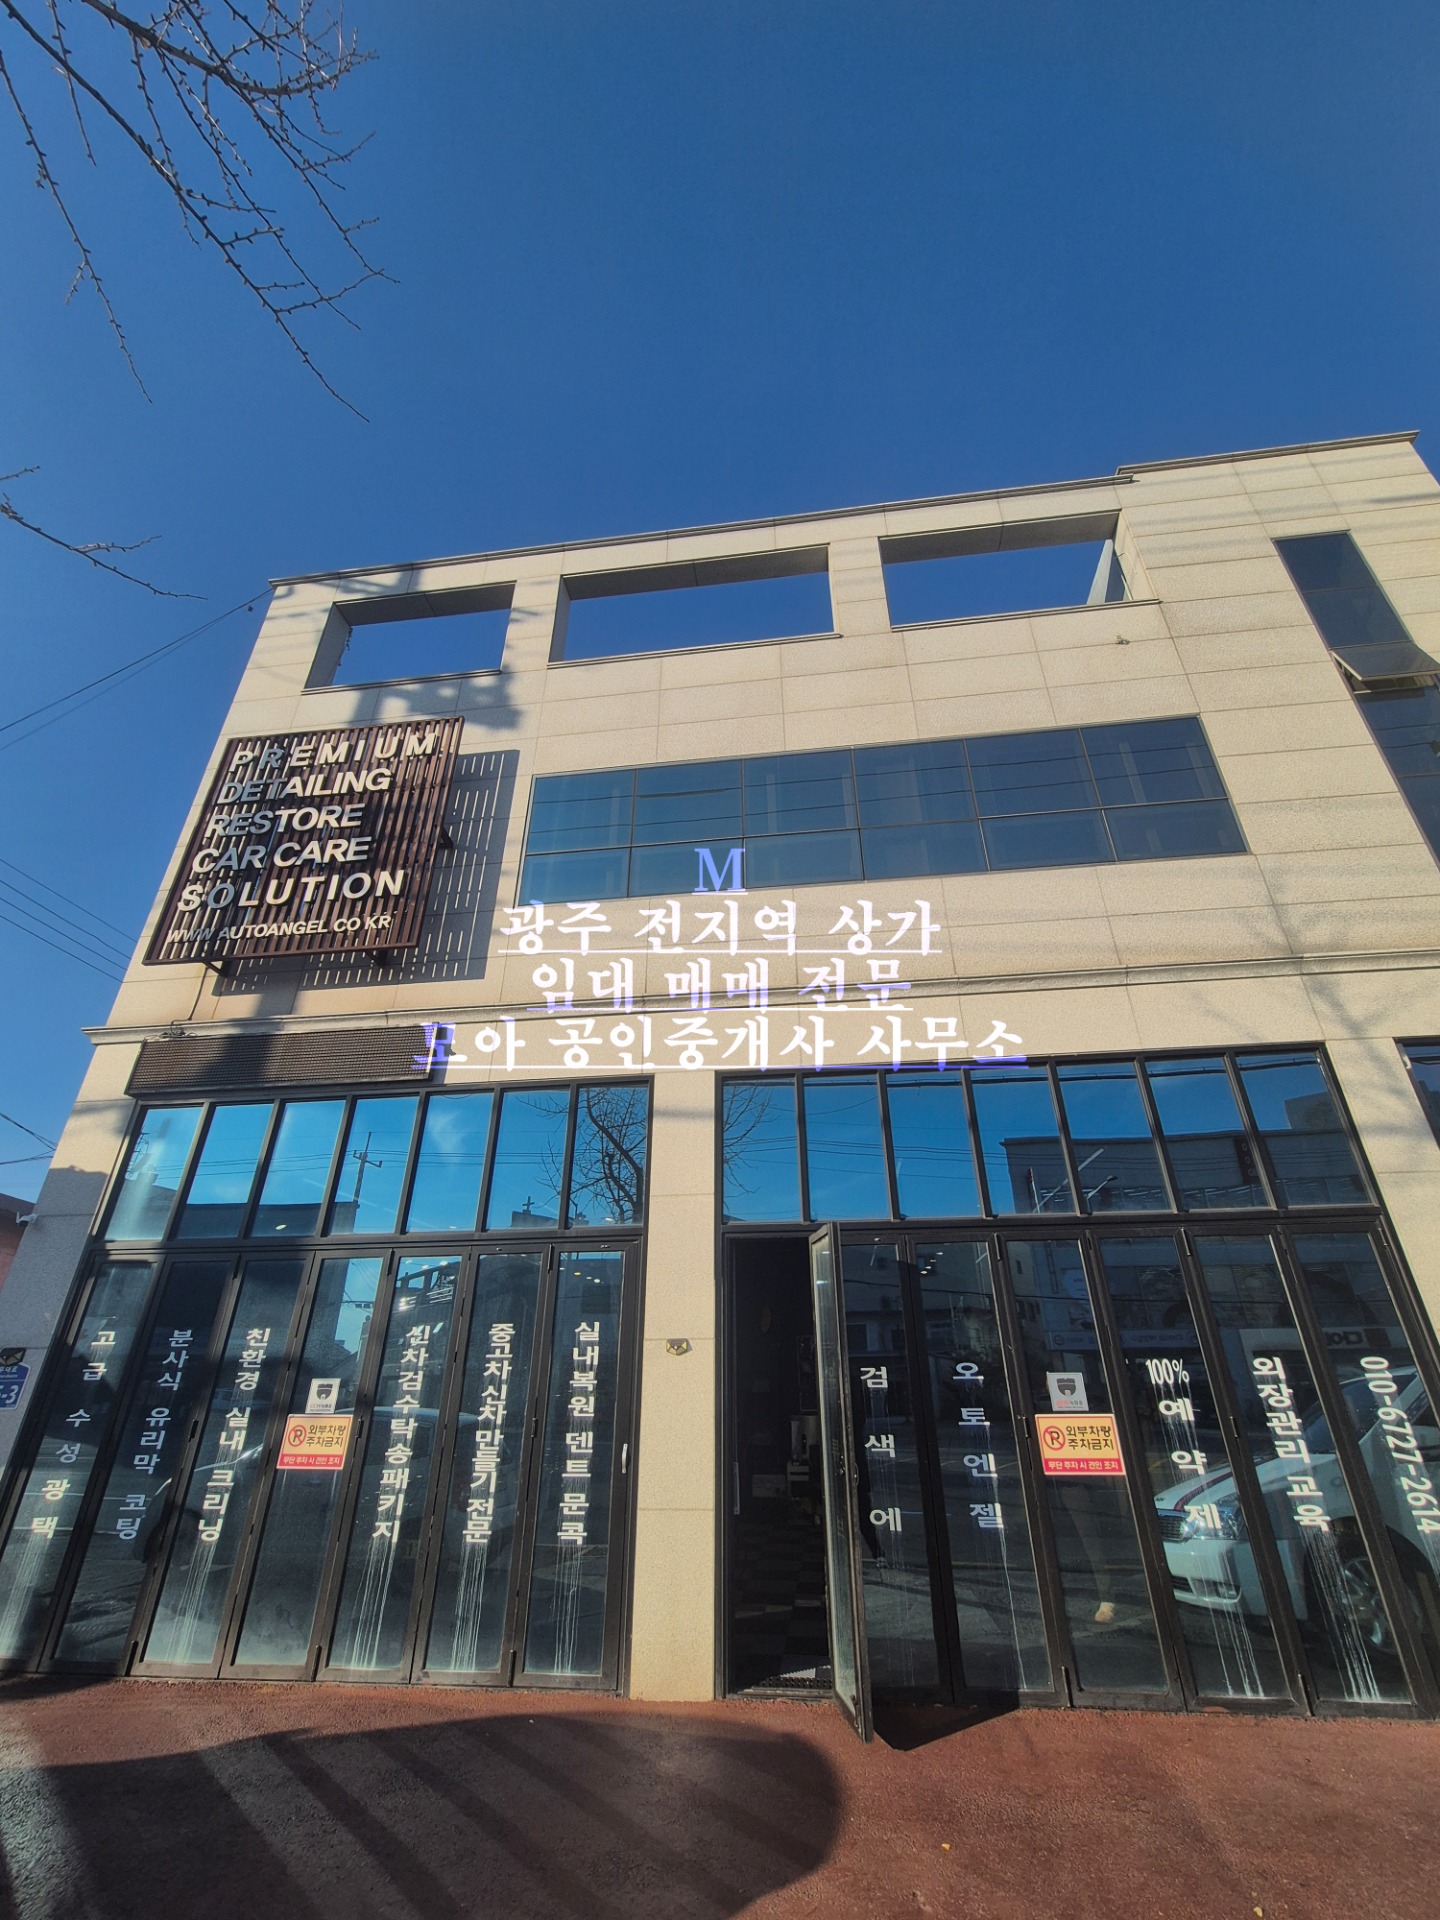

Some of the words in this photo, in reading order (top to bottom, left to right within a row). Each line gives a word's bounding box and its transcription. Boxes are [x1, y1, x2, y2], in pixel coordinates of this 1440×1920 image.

[228, 732, 438, 772] PREMIUM
[217, 768, 392, 804] DETAILING
[206, 803, 365, 838] RESTORE
[192, 845, 267, 873] CAR
[273, 837, 372, 868] CARE
[178, 870, 404, 912] SOLUTION
[218, 920, 328, 940] AUTOANGEL
[82, 1331, 116, 1381] 고급
[157, 1329, 193, 1391] 분사식
[235, 1328, 270, 1390] 친환경
[484, 1323, 515, 1380] 중고차
[568, 1321, 600, 1418] 실내복원
[1145, 1358, 1190, 1385] 100%
[477, 1384, 507, 1425] 신차
[133, 1408, 172, 1475] 유리막
[219, 1408, 251, 1451] 실내
[306, 1436, 343, 1447] 주차금지
[308, 1425, 346, 1435] 외부차량
[860, 1366, 902, 1531] 검색에
[953, 1362, 1004, 1528] 오토엔젤
[1066, 1426, 1111, 1437] 외부차량
[1068, 1439, 1114, 1450] 주차금지
[1252, 1356, 1310, 1464] 외장관리
[1286, 1476, 1331, 1532] 교육
[1360, 1356, 1440, 1534] 010-6727-2614
[32, 1409, 91, 1538] 수성광택
[470, 1430, 504, 1493] 만들기
[562, 1431, 593, 1478] 덴트
[1158, 1399, 1221, 1529] 예약제
[116, 1494, 146, 1540] 코팅
[198, 1469, 234, 1542] 크리닝
[462, 1499, 494, 1544] 전문
[557, 1494, 590, 1545] 문콕
